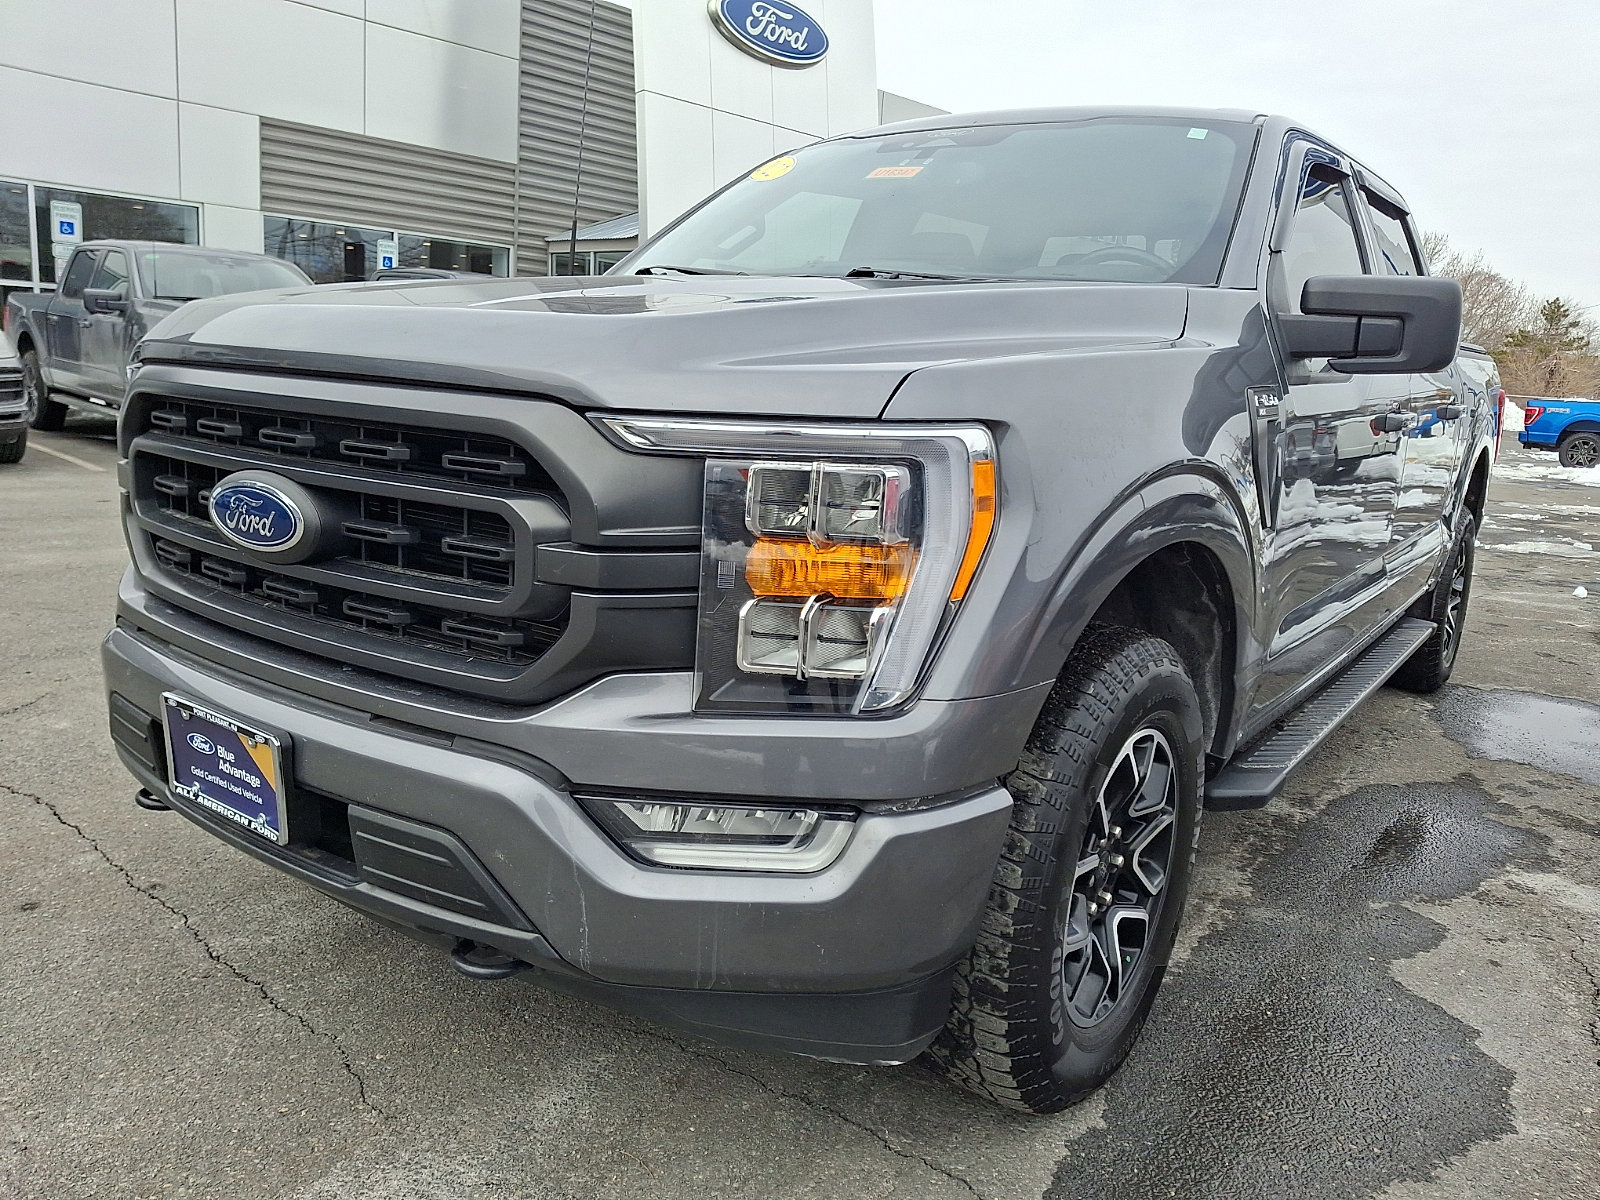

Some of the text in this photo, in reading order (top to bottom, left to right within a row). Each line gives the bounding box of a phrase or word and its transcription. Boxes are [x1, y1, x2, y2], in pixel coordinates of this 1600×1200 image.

[746, 1, 809, 51] Ford
[225, 494, 276, 537] Ford
[193, 707, 207, 719] POINT
[230, 723, 238, 732] NJ
[192, 735, 210, 752] Ford
[217, 745, 235, 763] Blue
[191, 765, 263, 805] Gold Certified Used Vehicle
[219, 759, 261, 788] Advantage
[176, 786, 278, 842] ALL AMERICAN FORD
